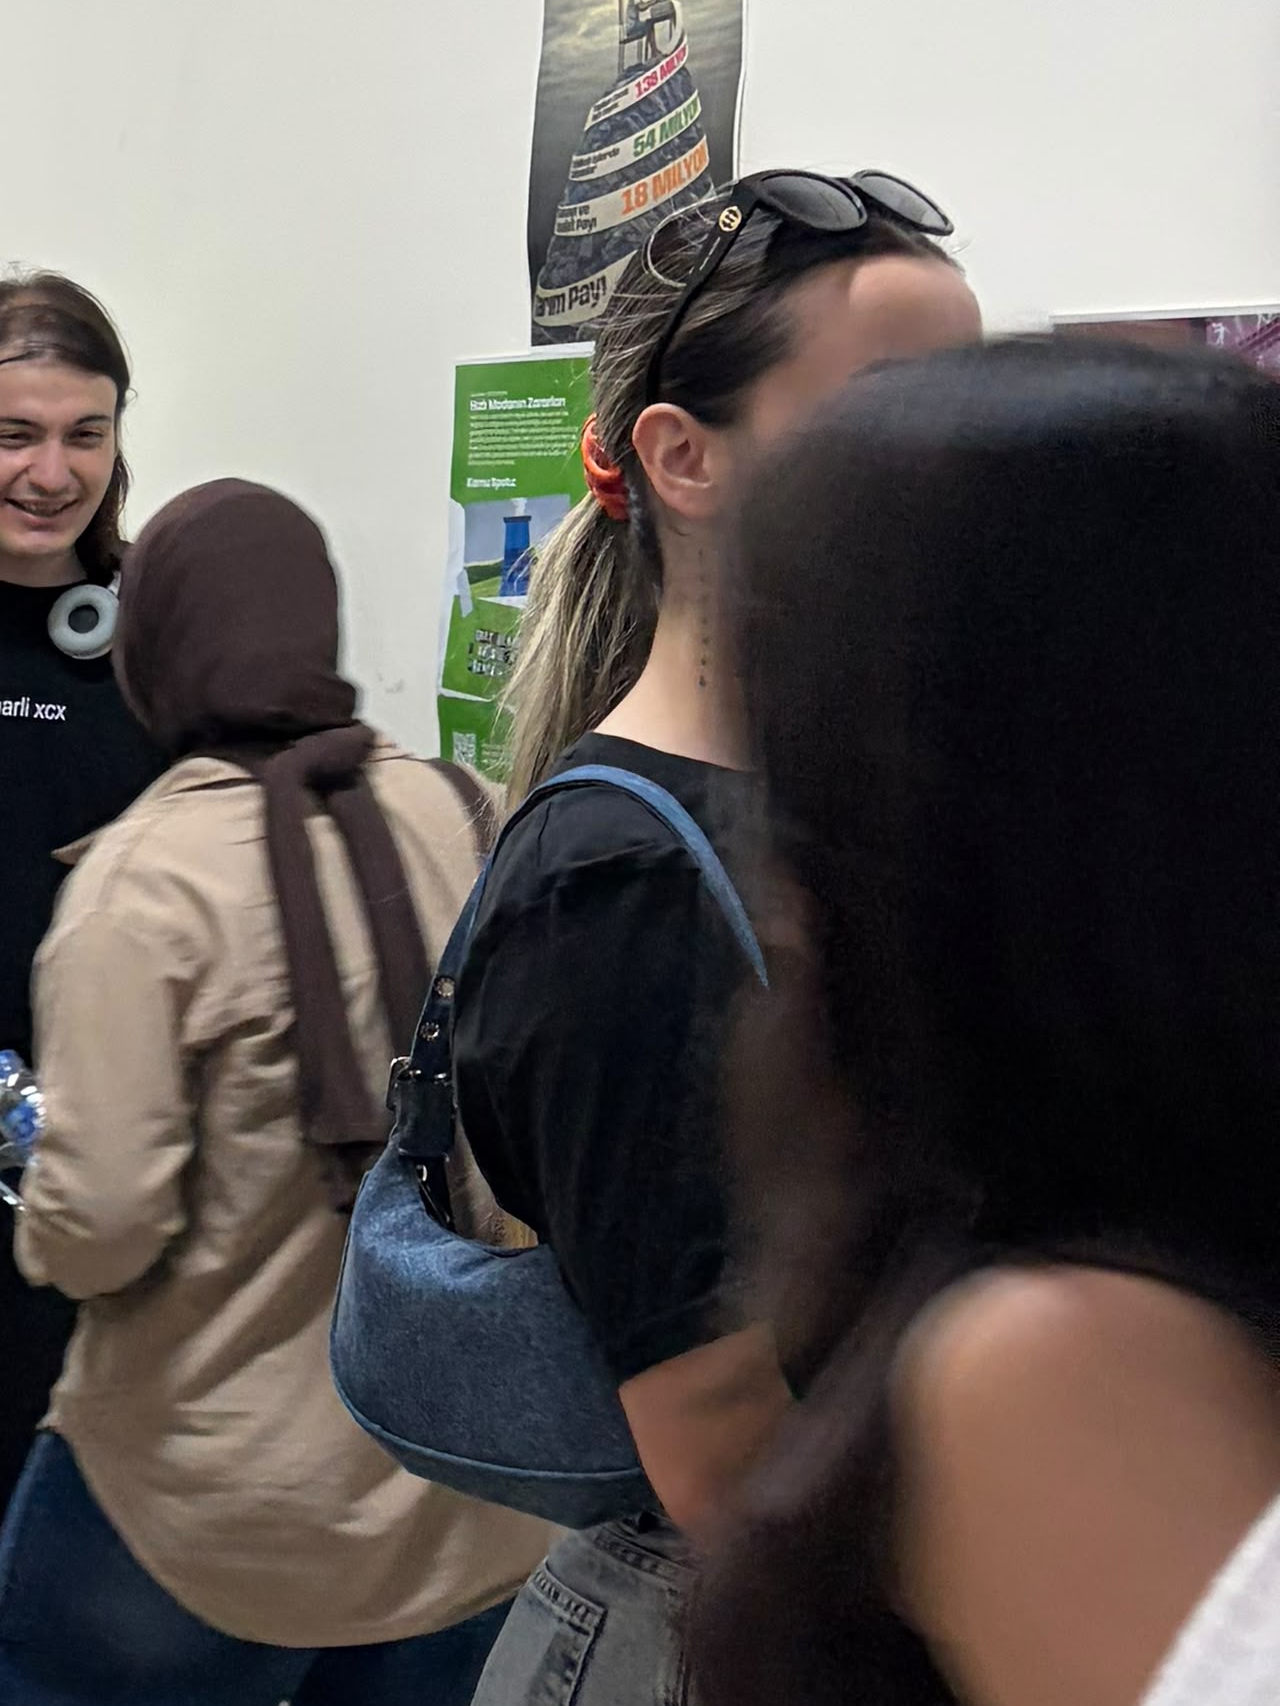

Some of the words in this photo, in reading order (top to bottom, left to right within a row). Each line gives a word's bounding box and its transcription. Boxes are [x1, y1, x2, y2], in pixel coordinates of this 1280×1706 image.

[632, 129, 657, 157] 54
[620, 182, 648, 215] 18
[568, 275, 607, 309] Payı
[33, 703, 67, 721] xcx
